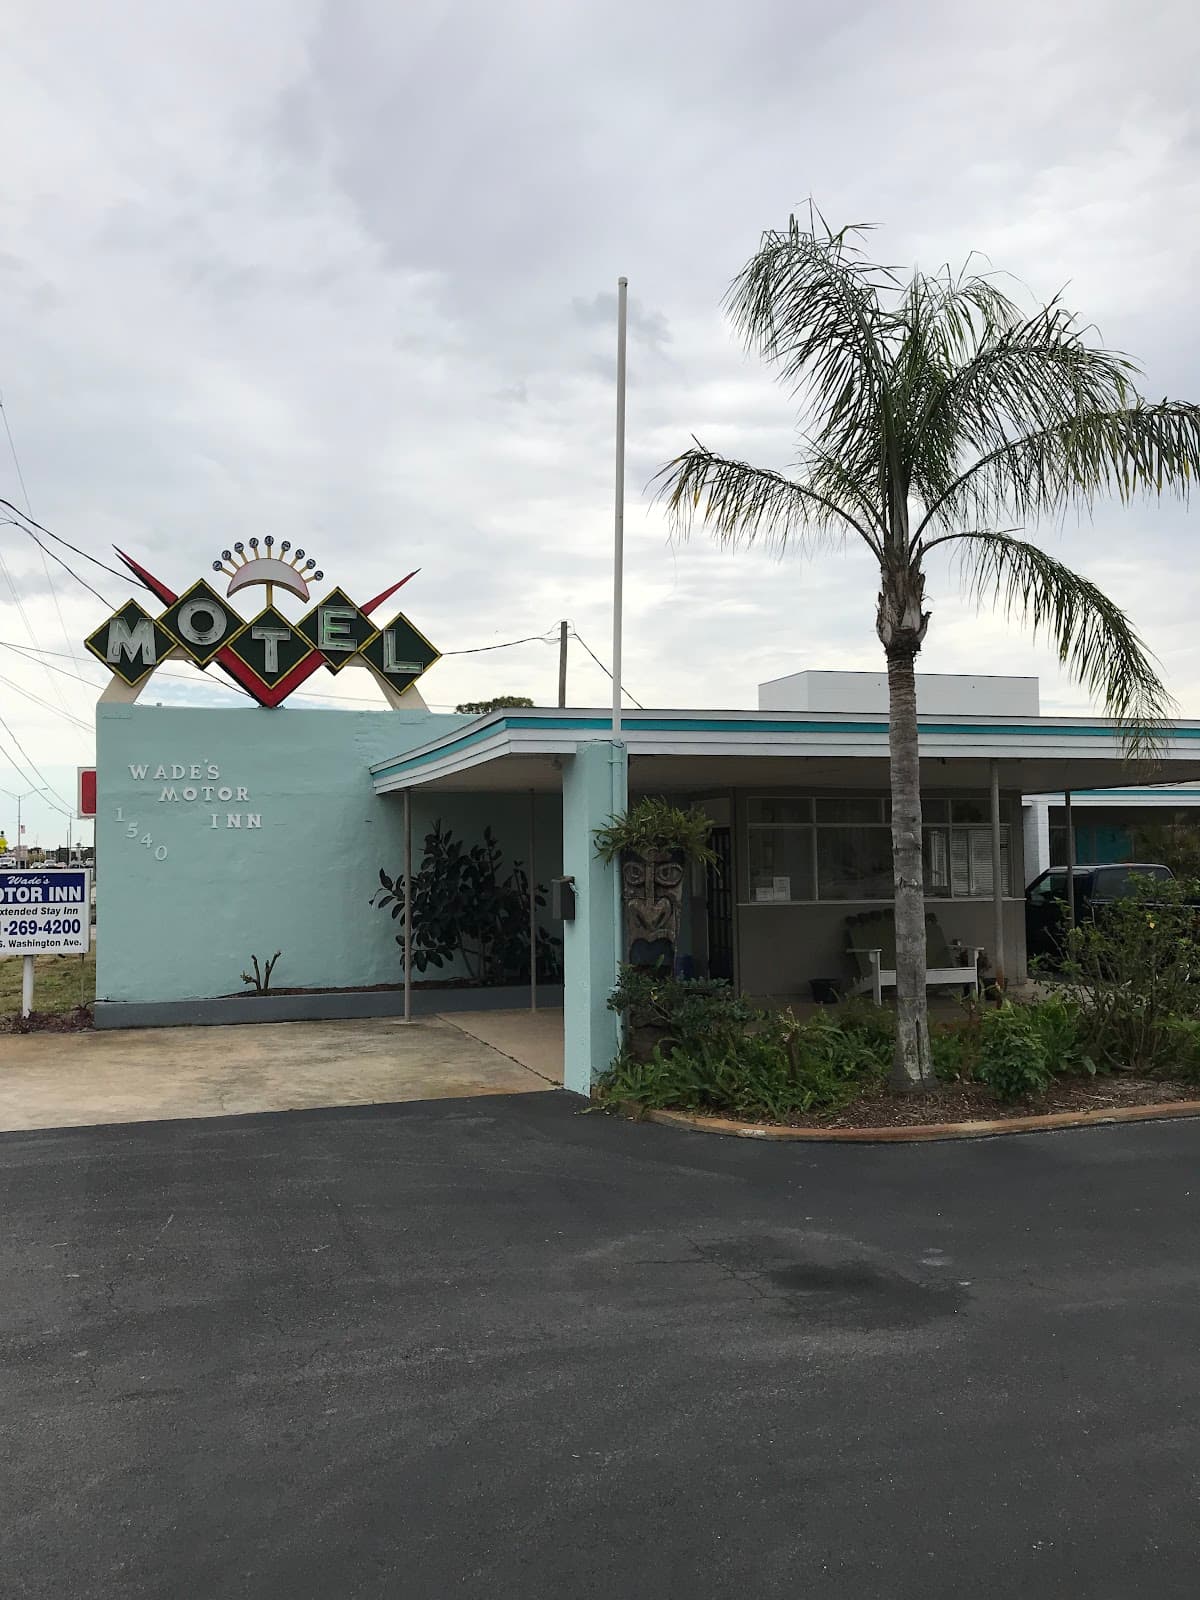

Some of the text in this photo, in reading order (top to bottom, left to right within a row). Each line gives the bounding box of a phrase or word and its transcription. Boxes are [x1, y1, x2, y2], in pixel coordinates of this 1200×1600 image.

[106, 597, 424, 675] MOTEL
[128, 758, 221, 781] WADE'S
[158, 786, 250, 802] MOTOR
[210, 813, 263, 829] INN
[113, 807, 168, 861] 1540
[7, 875, 50, 885] Wade's
[48, 886, 82, 902] INN
[40, 907, 61, 917] Stay
[63, 906, 79, 915] Inn
[0, 918, 81, 936] -269-4200
[8, 938, 61, 949] Washington
[63, 938, 82, 947] Ave.
